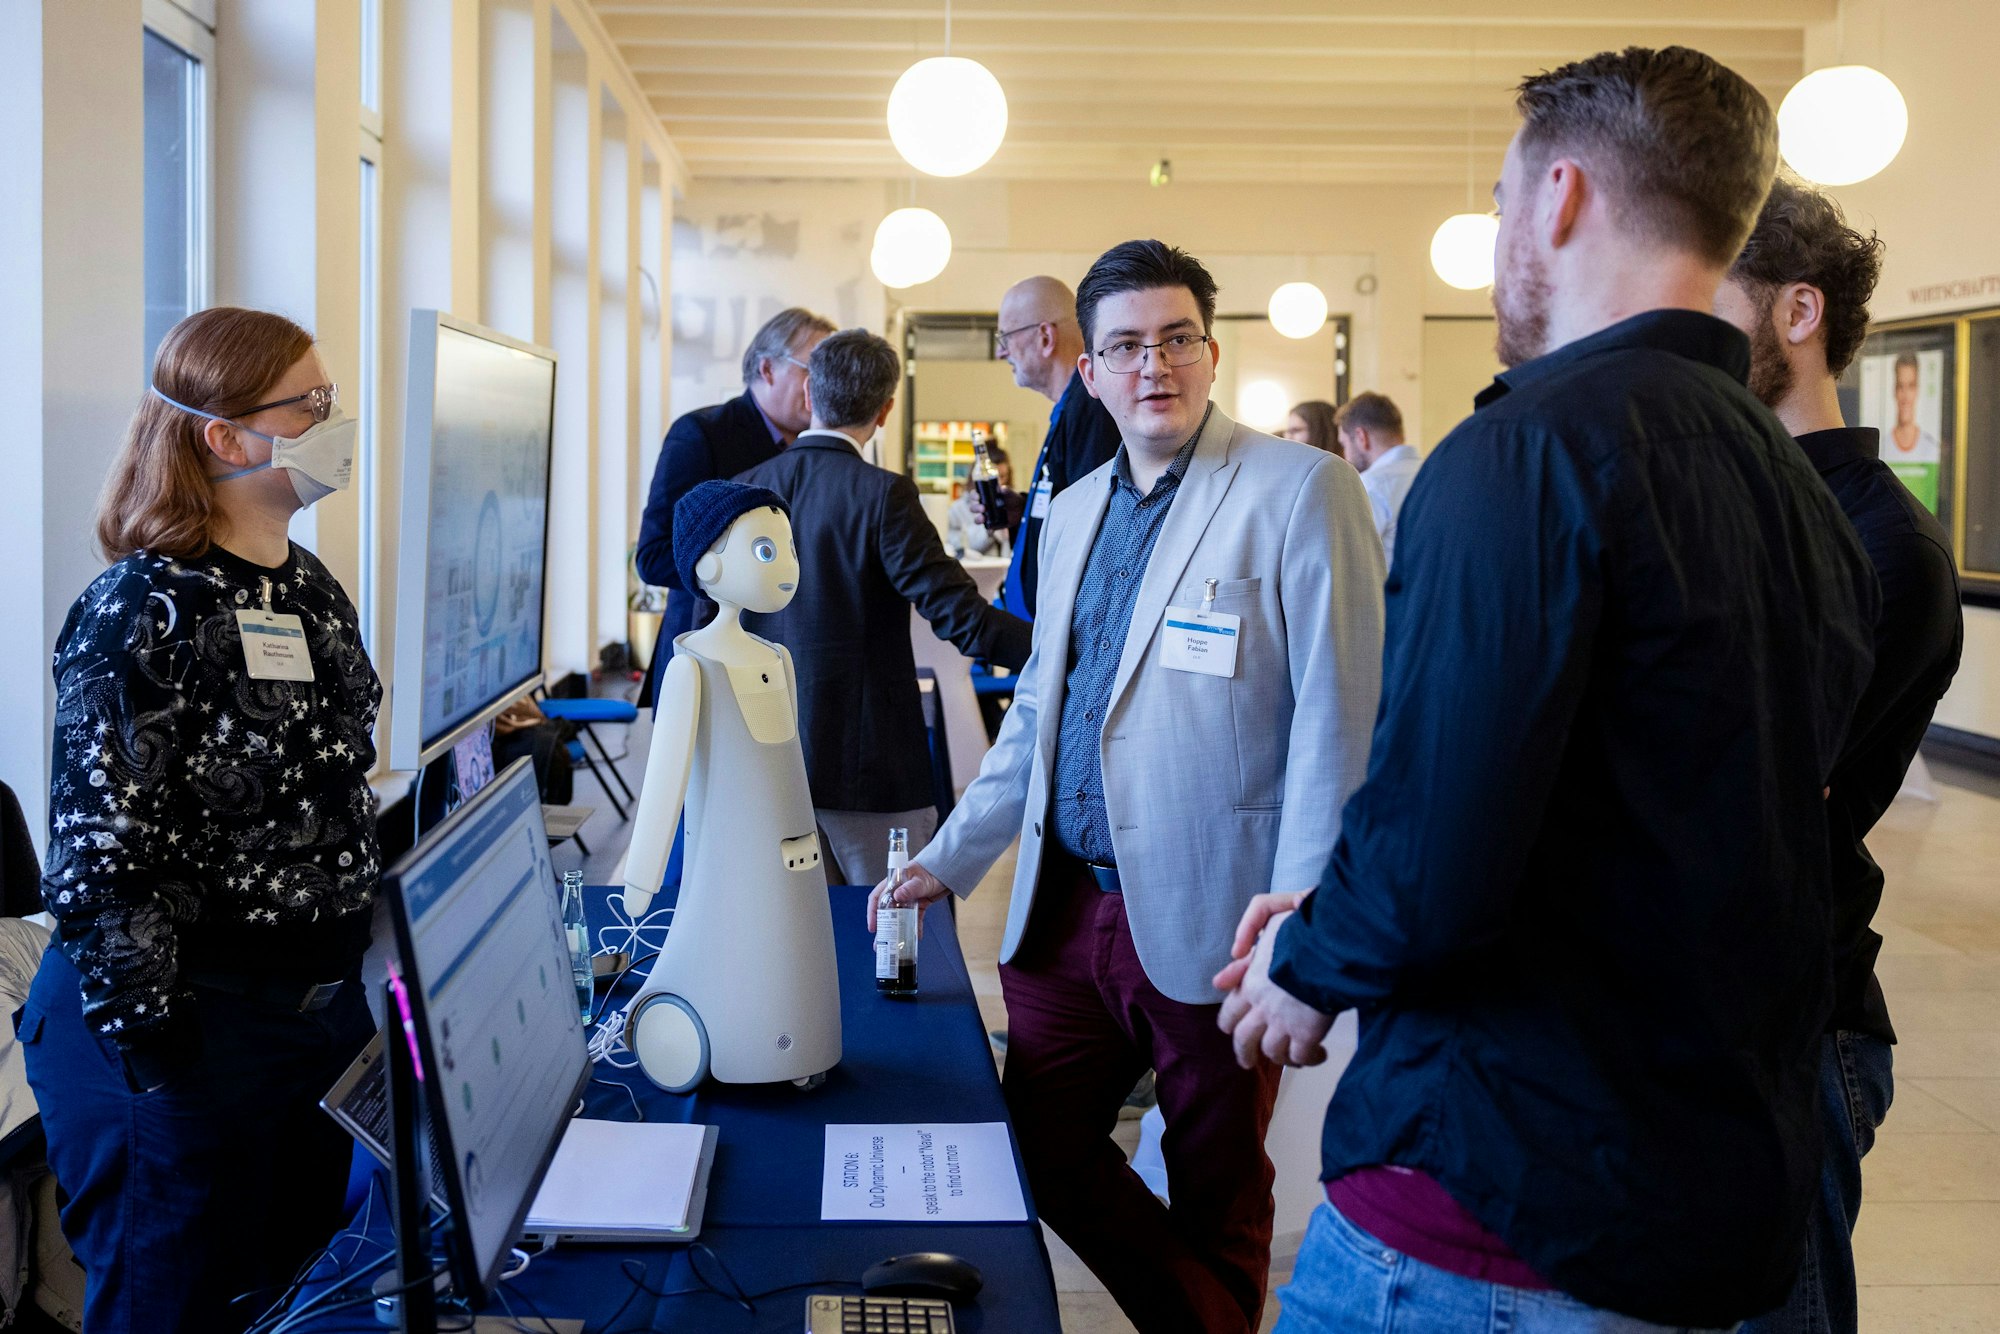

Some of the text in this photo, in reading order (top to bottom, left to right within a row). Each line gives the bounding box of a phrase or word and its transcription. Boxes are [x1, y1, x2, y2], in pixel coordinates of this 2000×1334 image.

[1187, 636, 1208, 646] Hoppe
[1187, 644, 1209, 653] Fabian
[920, 1154, 935, 1171] robot
[946, 1144, 963, 1197] to find out more
[843, 1159, 859, 1188] STATION
[869, 1136, 888, 1208] Our Dynamic Universe
[921, 1172, 936, 1184] the
[922, 1184, 937, 1192] to
[922, 1192, 942, 1215] speak
